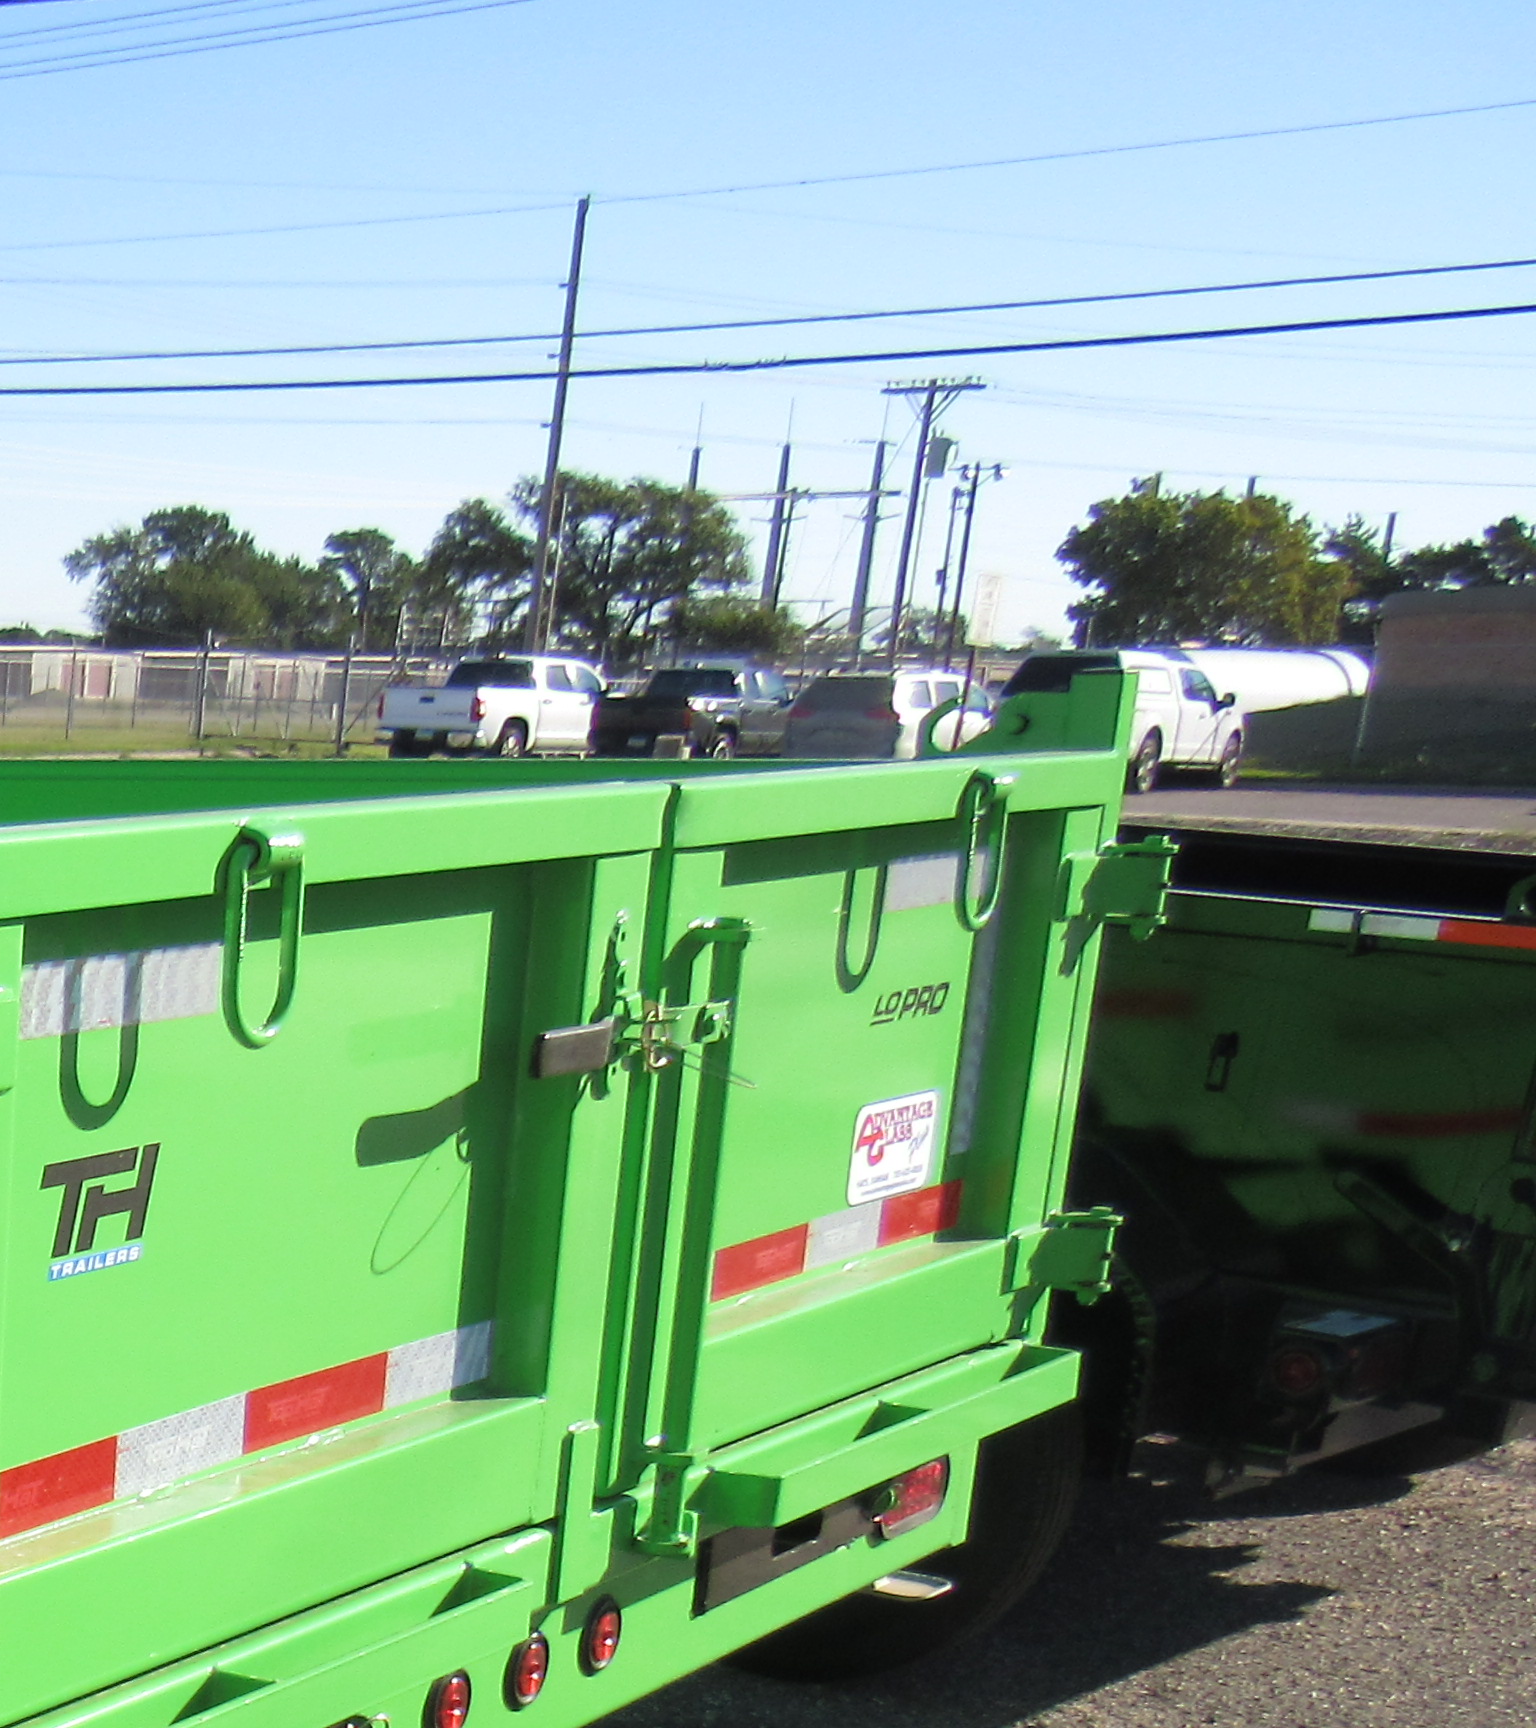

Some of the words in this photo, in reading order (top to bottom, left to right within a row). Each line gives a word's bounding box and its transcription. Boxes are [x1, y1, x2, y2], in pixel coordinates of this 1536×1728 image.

[872, 991, 902, 1020] LO
[898, 982, 950, 1020] PRO
[39, 1142, 162, 1258] TH
[50, 1246, 140, 1280] TRAILERS
